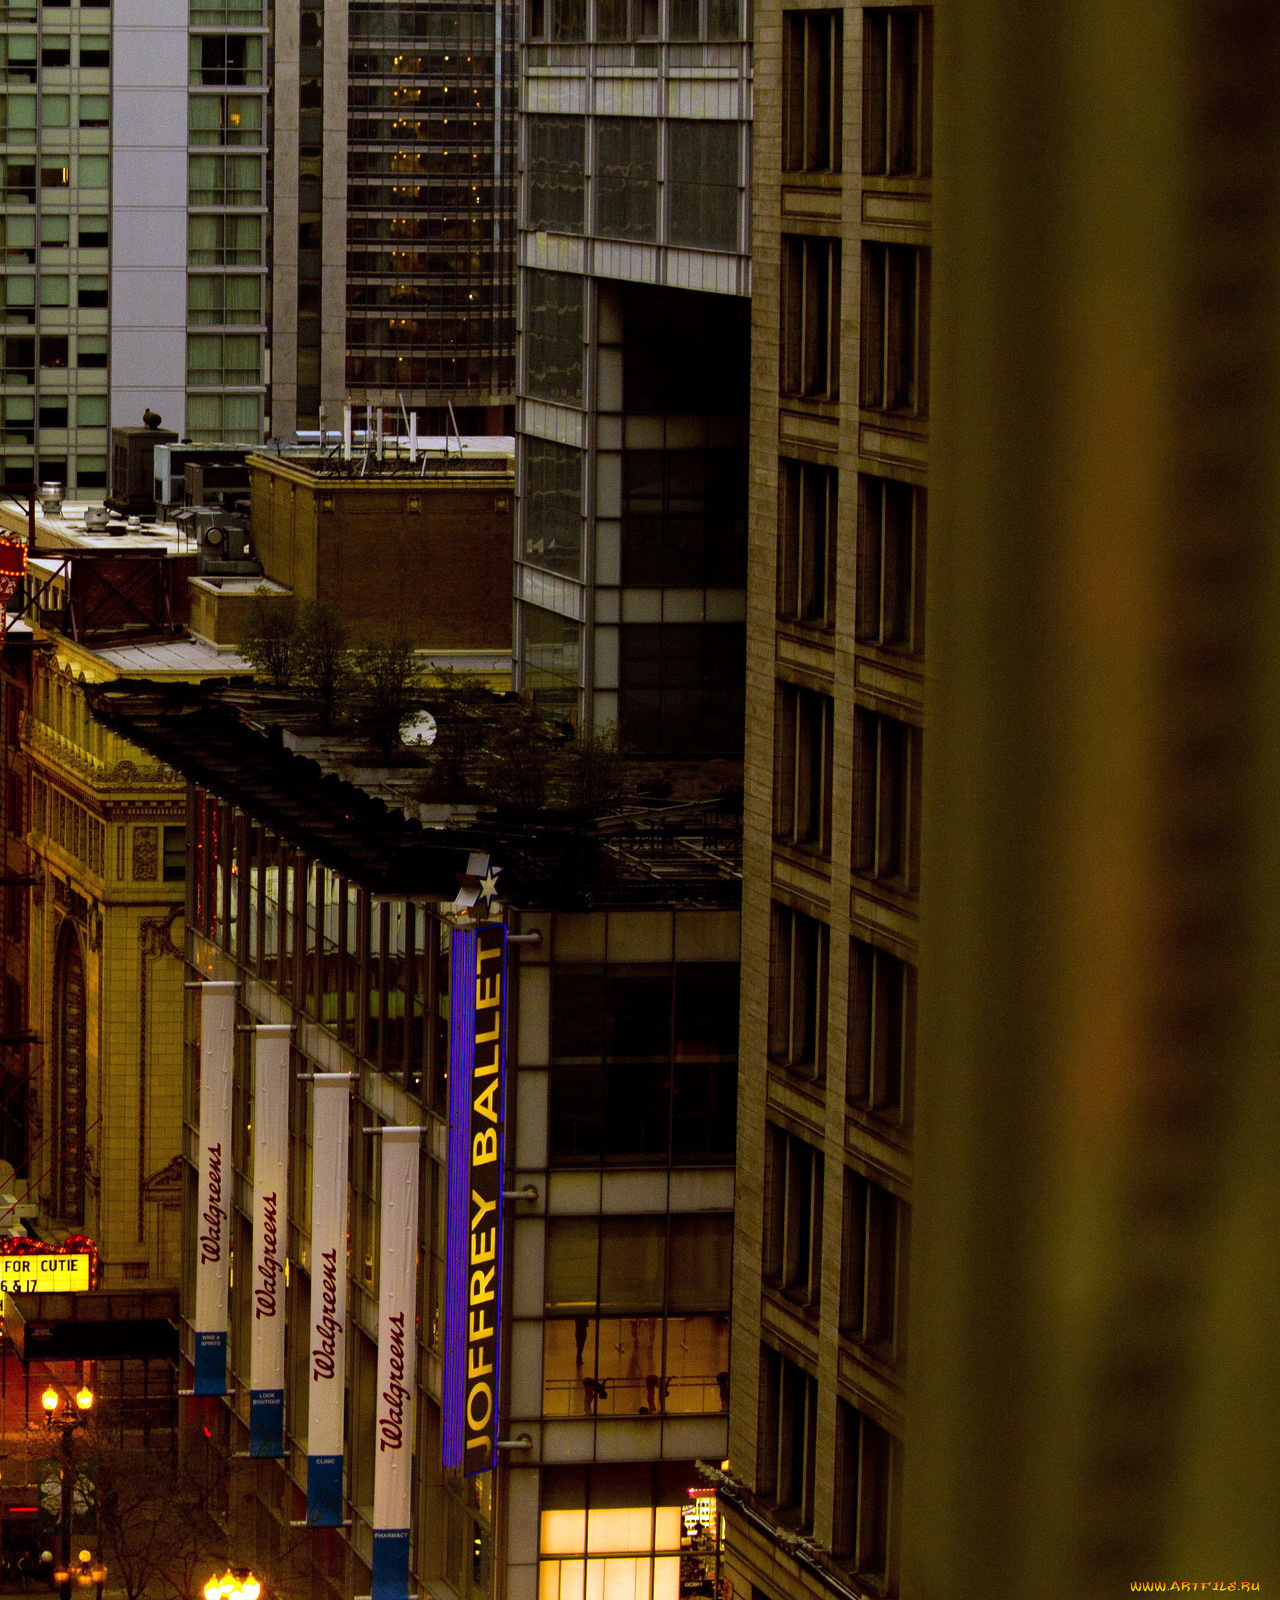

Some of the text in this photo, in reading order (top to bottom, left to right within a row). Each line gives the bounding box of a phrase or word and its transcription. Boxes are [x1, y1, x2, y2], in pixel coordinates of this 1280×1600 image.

[201, 1142, 221, 1265] Walgreens
[256, 1191, 277, 1319] Walgreens
[466, 937, 501, 1461] JOFFREY BALLET
[5, 1260, 30, 1272] FOR
[41, 1259, 78, 1272] CUTIE
[12, 1280, 22, 1292] &
[26, 1280, 38, 1292] 17
[313, 1247, 337, 1382] Walgreens
[380, 1311, 405, 1452] Walgreens
